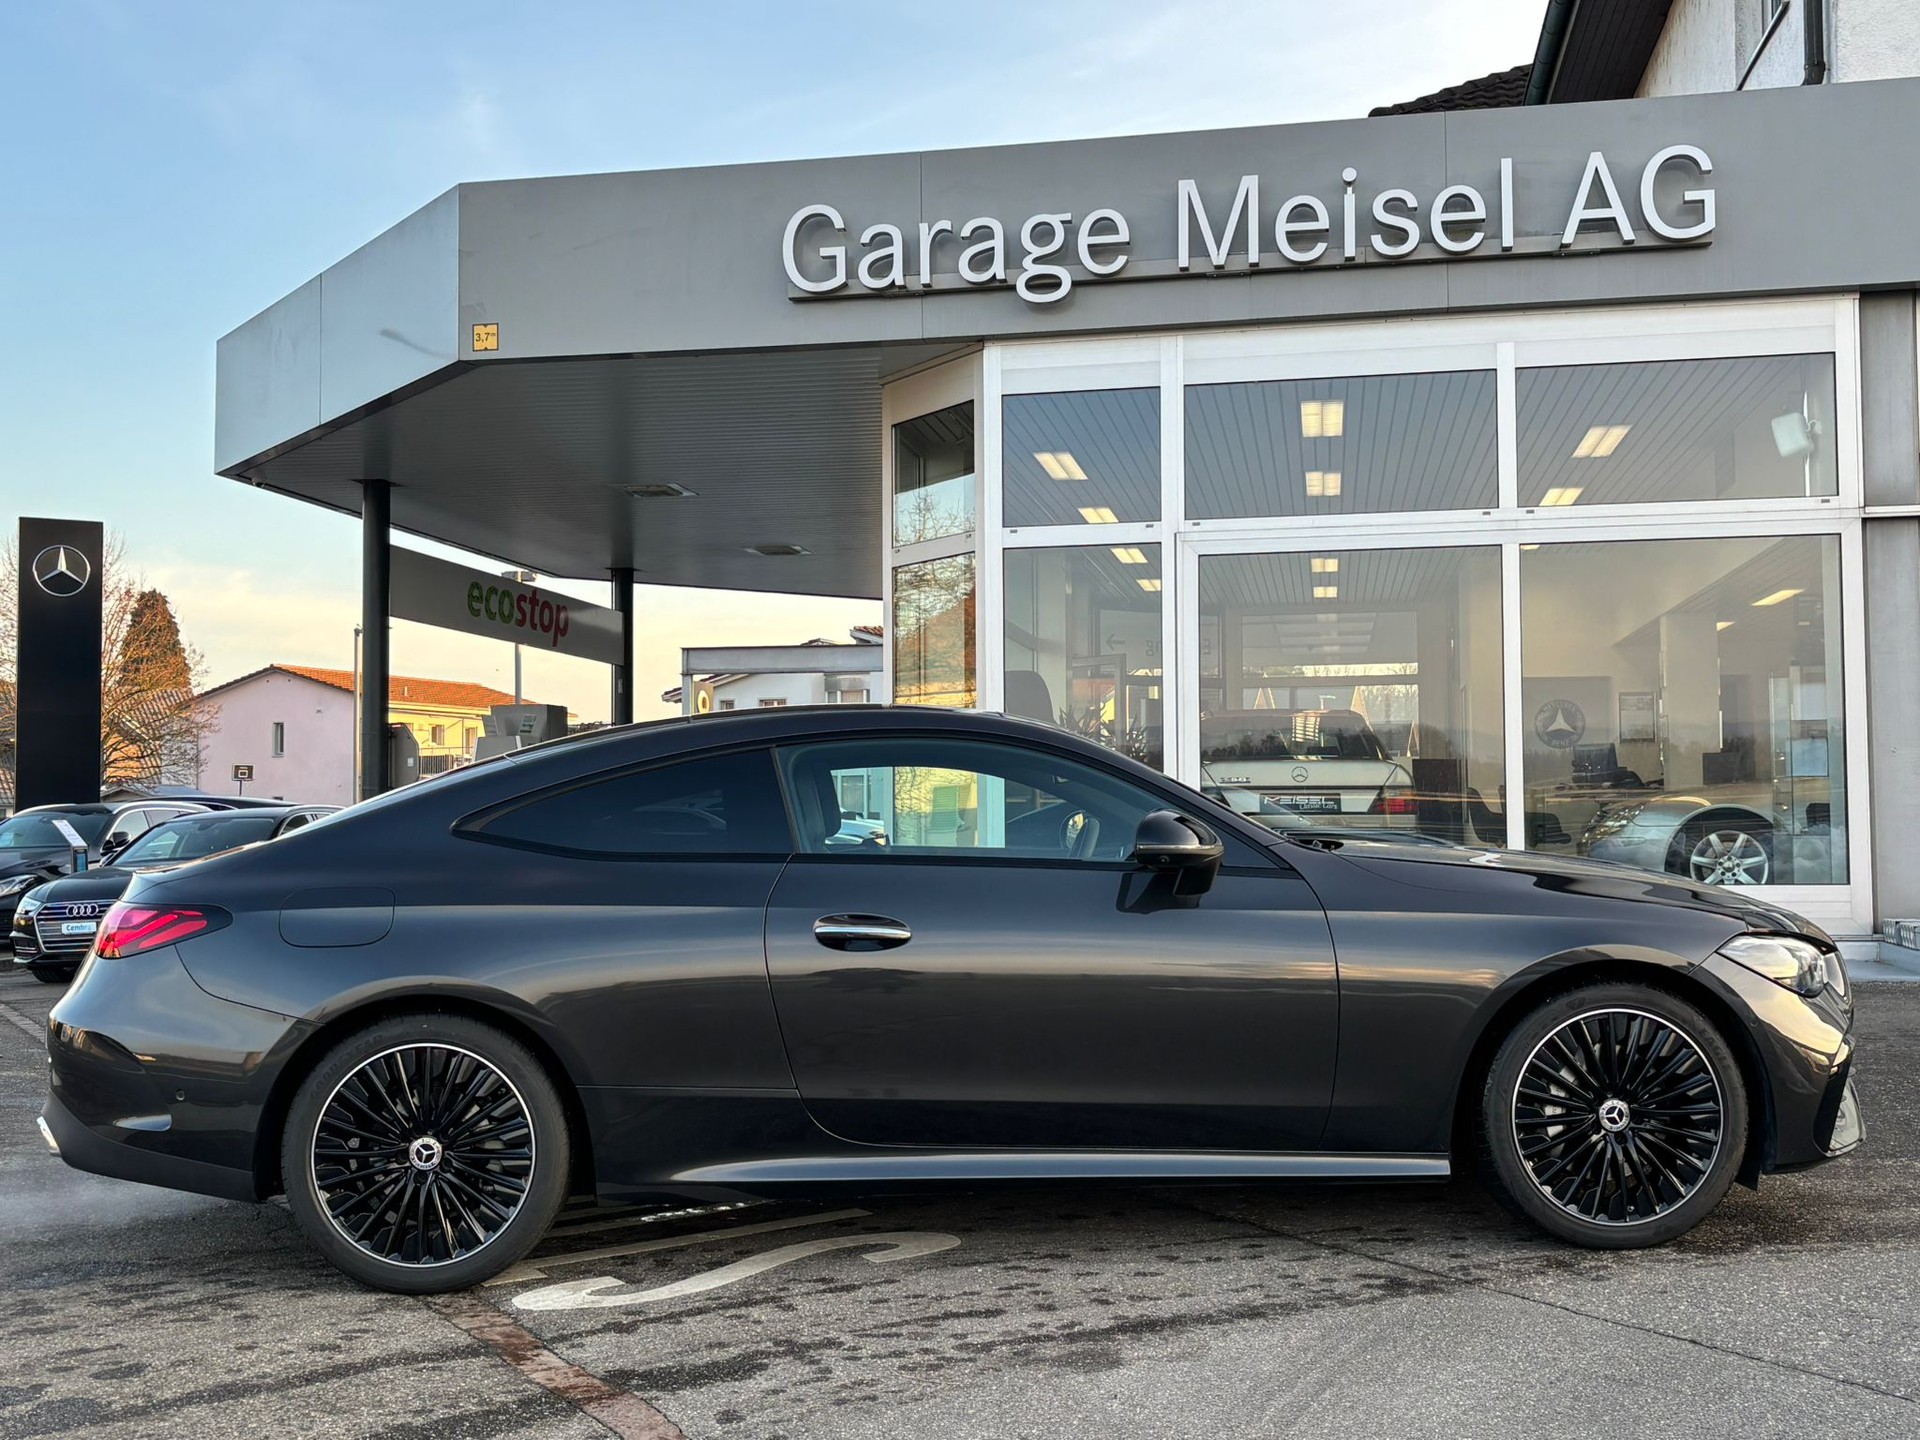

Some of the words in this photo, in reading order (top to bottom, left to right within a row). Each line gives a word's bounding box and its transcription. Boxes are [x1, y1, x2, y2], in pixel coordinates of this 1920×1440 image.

[782, 204, 1131, 303] Garage
[1177, 157, 1514, 271] Meisel
[1559, 144, 1716, 246] AG
[467, 581, 569, 647] ecostop
[1264, 795, 1335, 805] MEISEL
